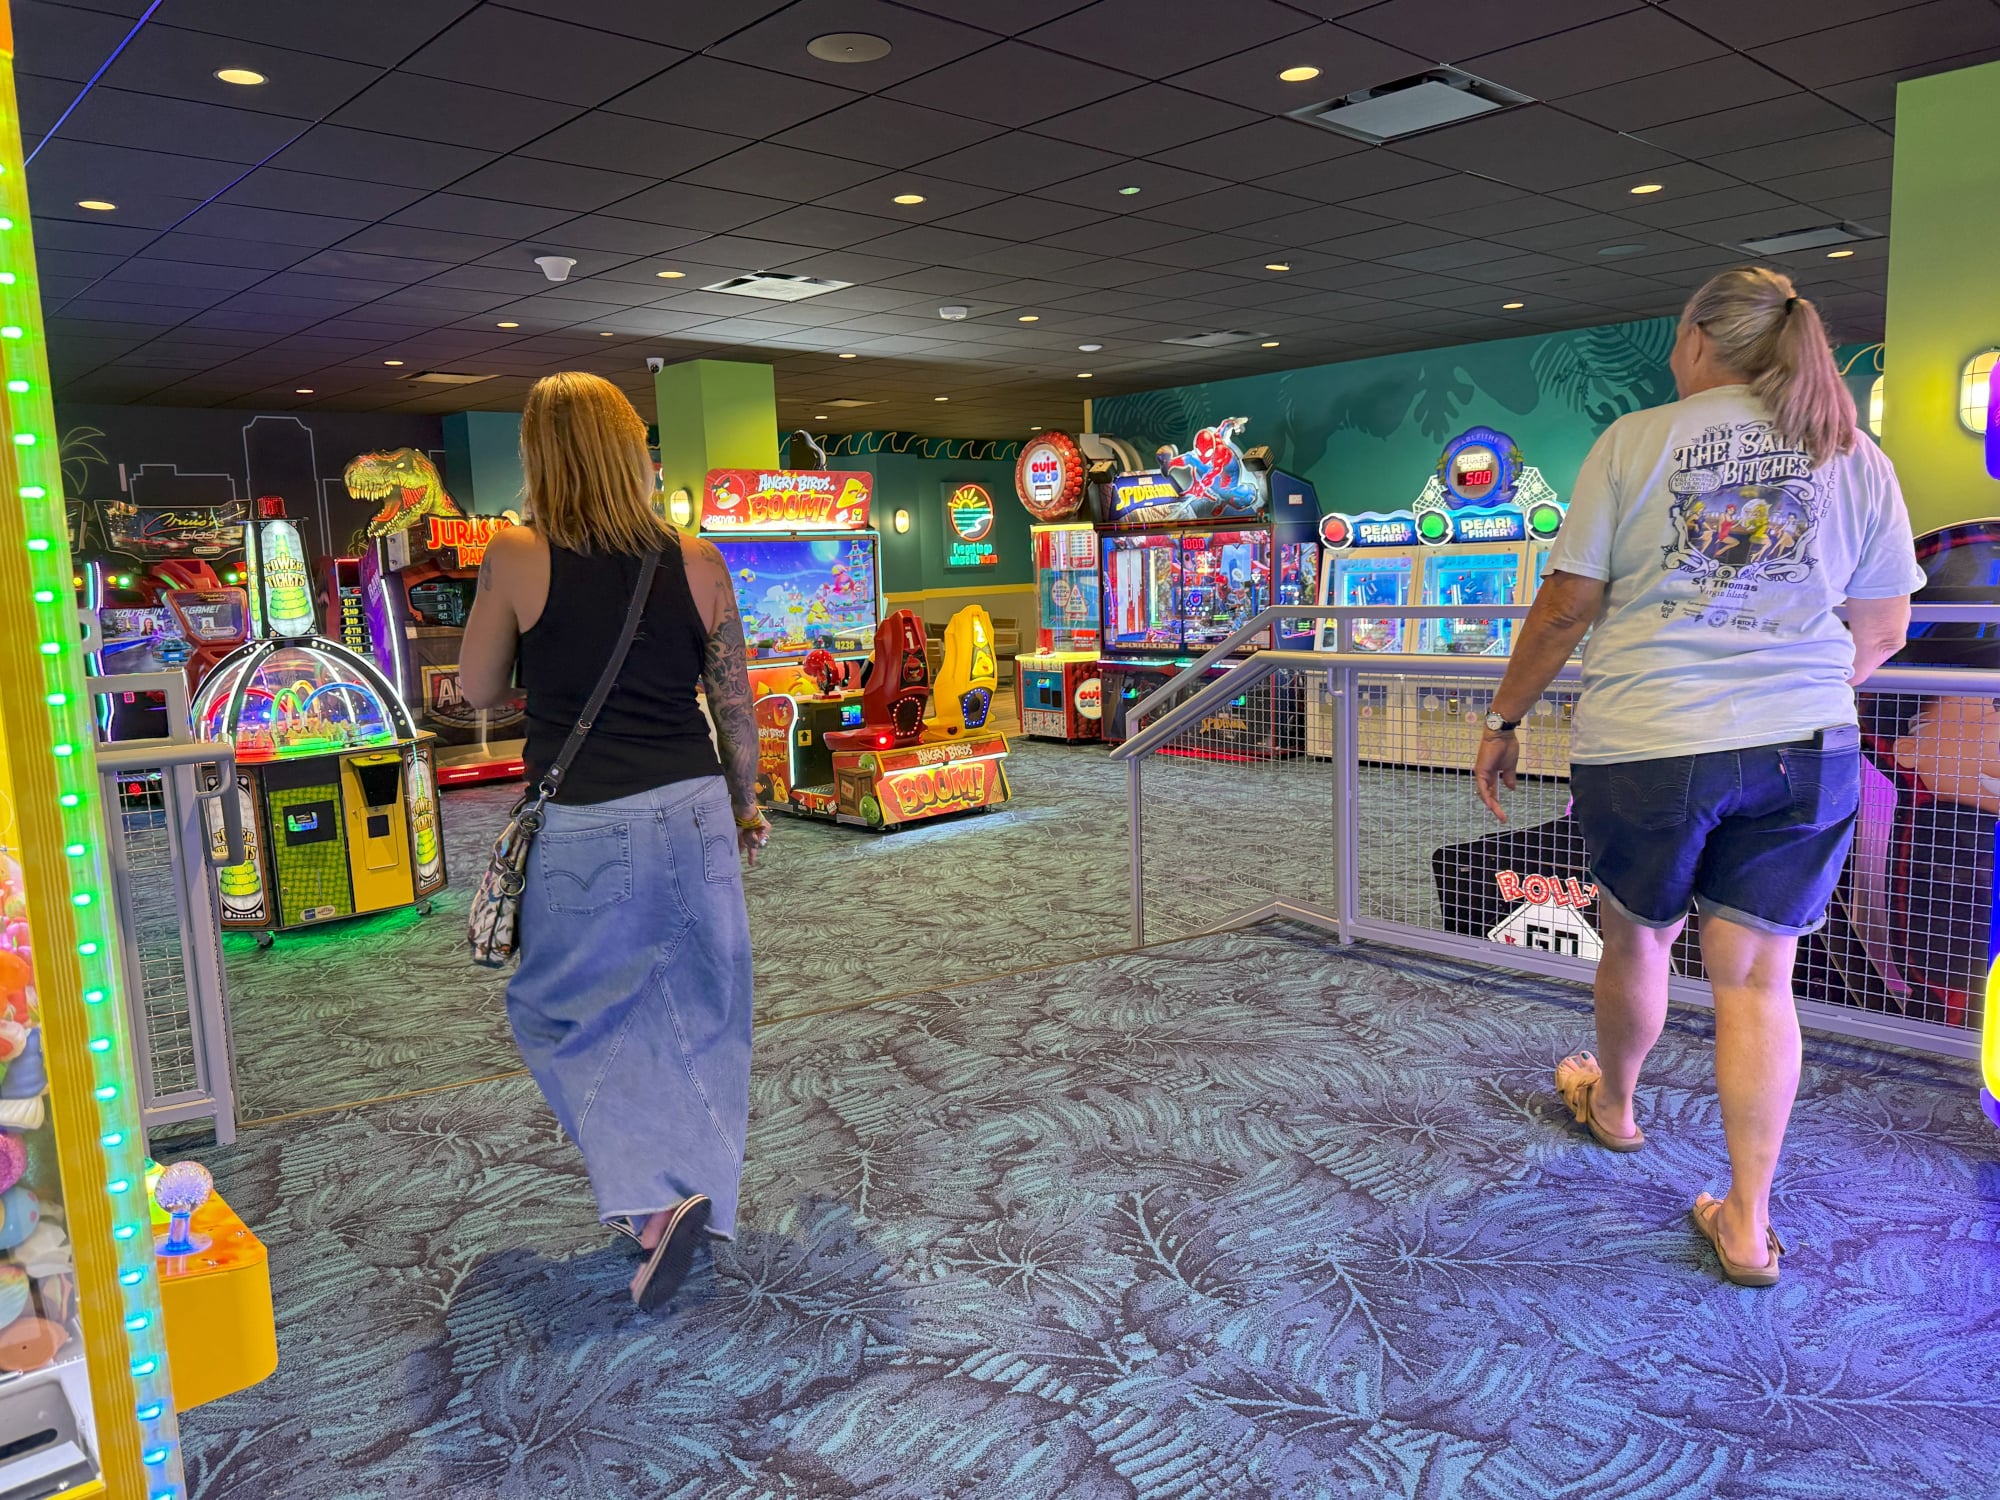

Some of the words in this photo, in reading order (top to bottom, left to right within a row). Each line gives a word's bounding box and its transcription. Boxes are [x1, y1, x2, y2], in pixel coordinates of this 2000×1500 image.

[1673, 442, 1730, 471] THE
[1465, 470, 1491, 486] 500
[1722, 456, 1812, 486] BITCHES
[757, 473, 795, 492] ANGRY
[797, 476, 831, 491] BIRDS
[750, 493, 833, 522] BOOM!
[180, 530, 221, 540] blast
[264, 552, 304, 574] TOWER
[458, 546, 487, 567] PAR
[265, 573, 307, 588] TICKETS
[1691, 577, 1706, 586] St
[1713, 580, 1759, 592] Thomas
[1699, 586, 1726, 598] Virgin
[905, 631, 915, 650] 1
[916, 746, 946, 765] ANGRY
[946, 743, 974, 761] BIRDS
[899, 765, 985, 814] BOOM!
